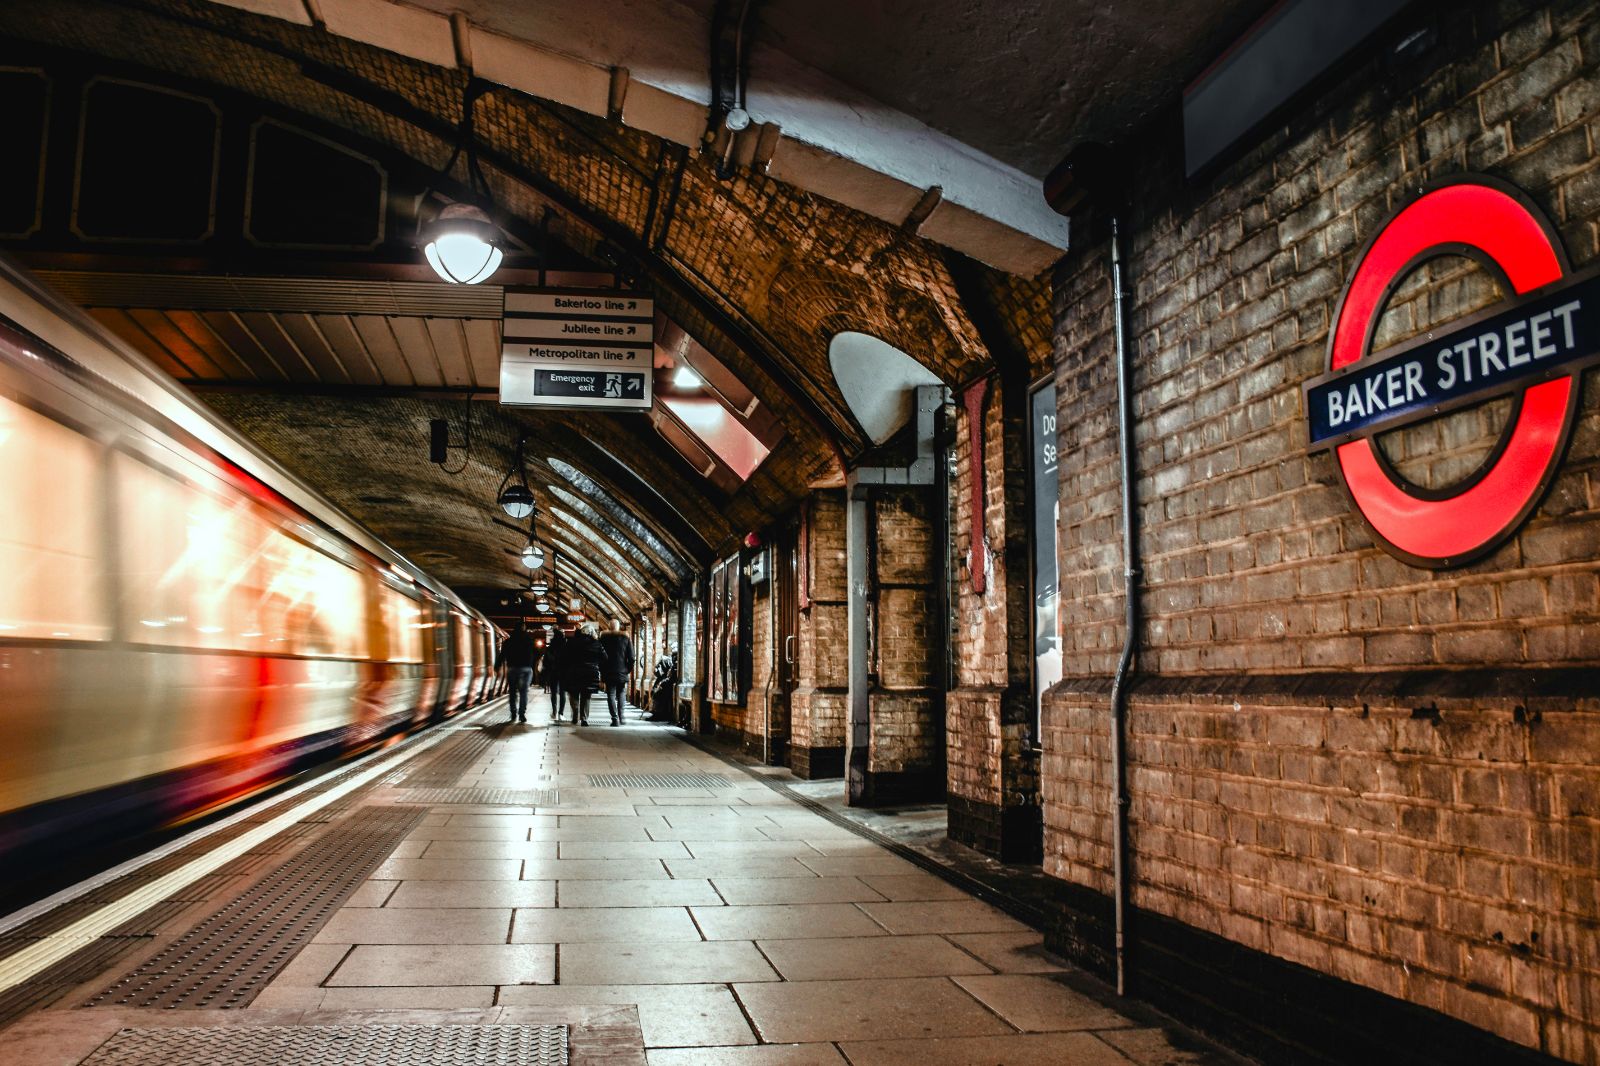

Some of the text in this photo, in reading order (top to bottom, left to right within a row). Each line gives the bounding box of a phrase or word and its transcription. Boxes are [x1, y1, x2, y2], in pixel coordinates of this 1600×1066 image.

[554, 298, 624, 310] Bakerloo line
[561, 324, 624, 335] Jubilee line
[529, 348, 623, 360] Metropolitan line
[1327, 300, 1581, 428] BAKER STREET
[550, 374, 595, 384] Emergency
[578, 384, 595, 392] exit
